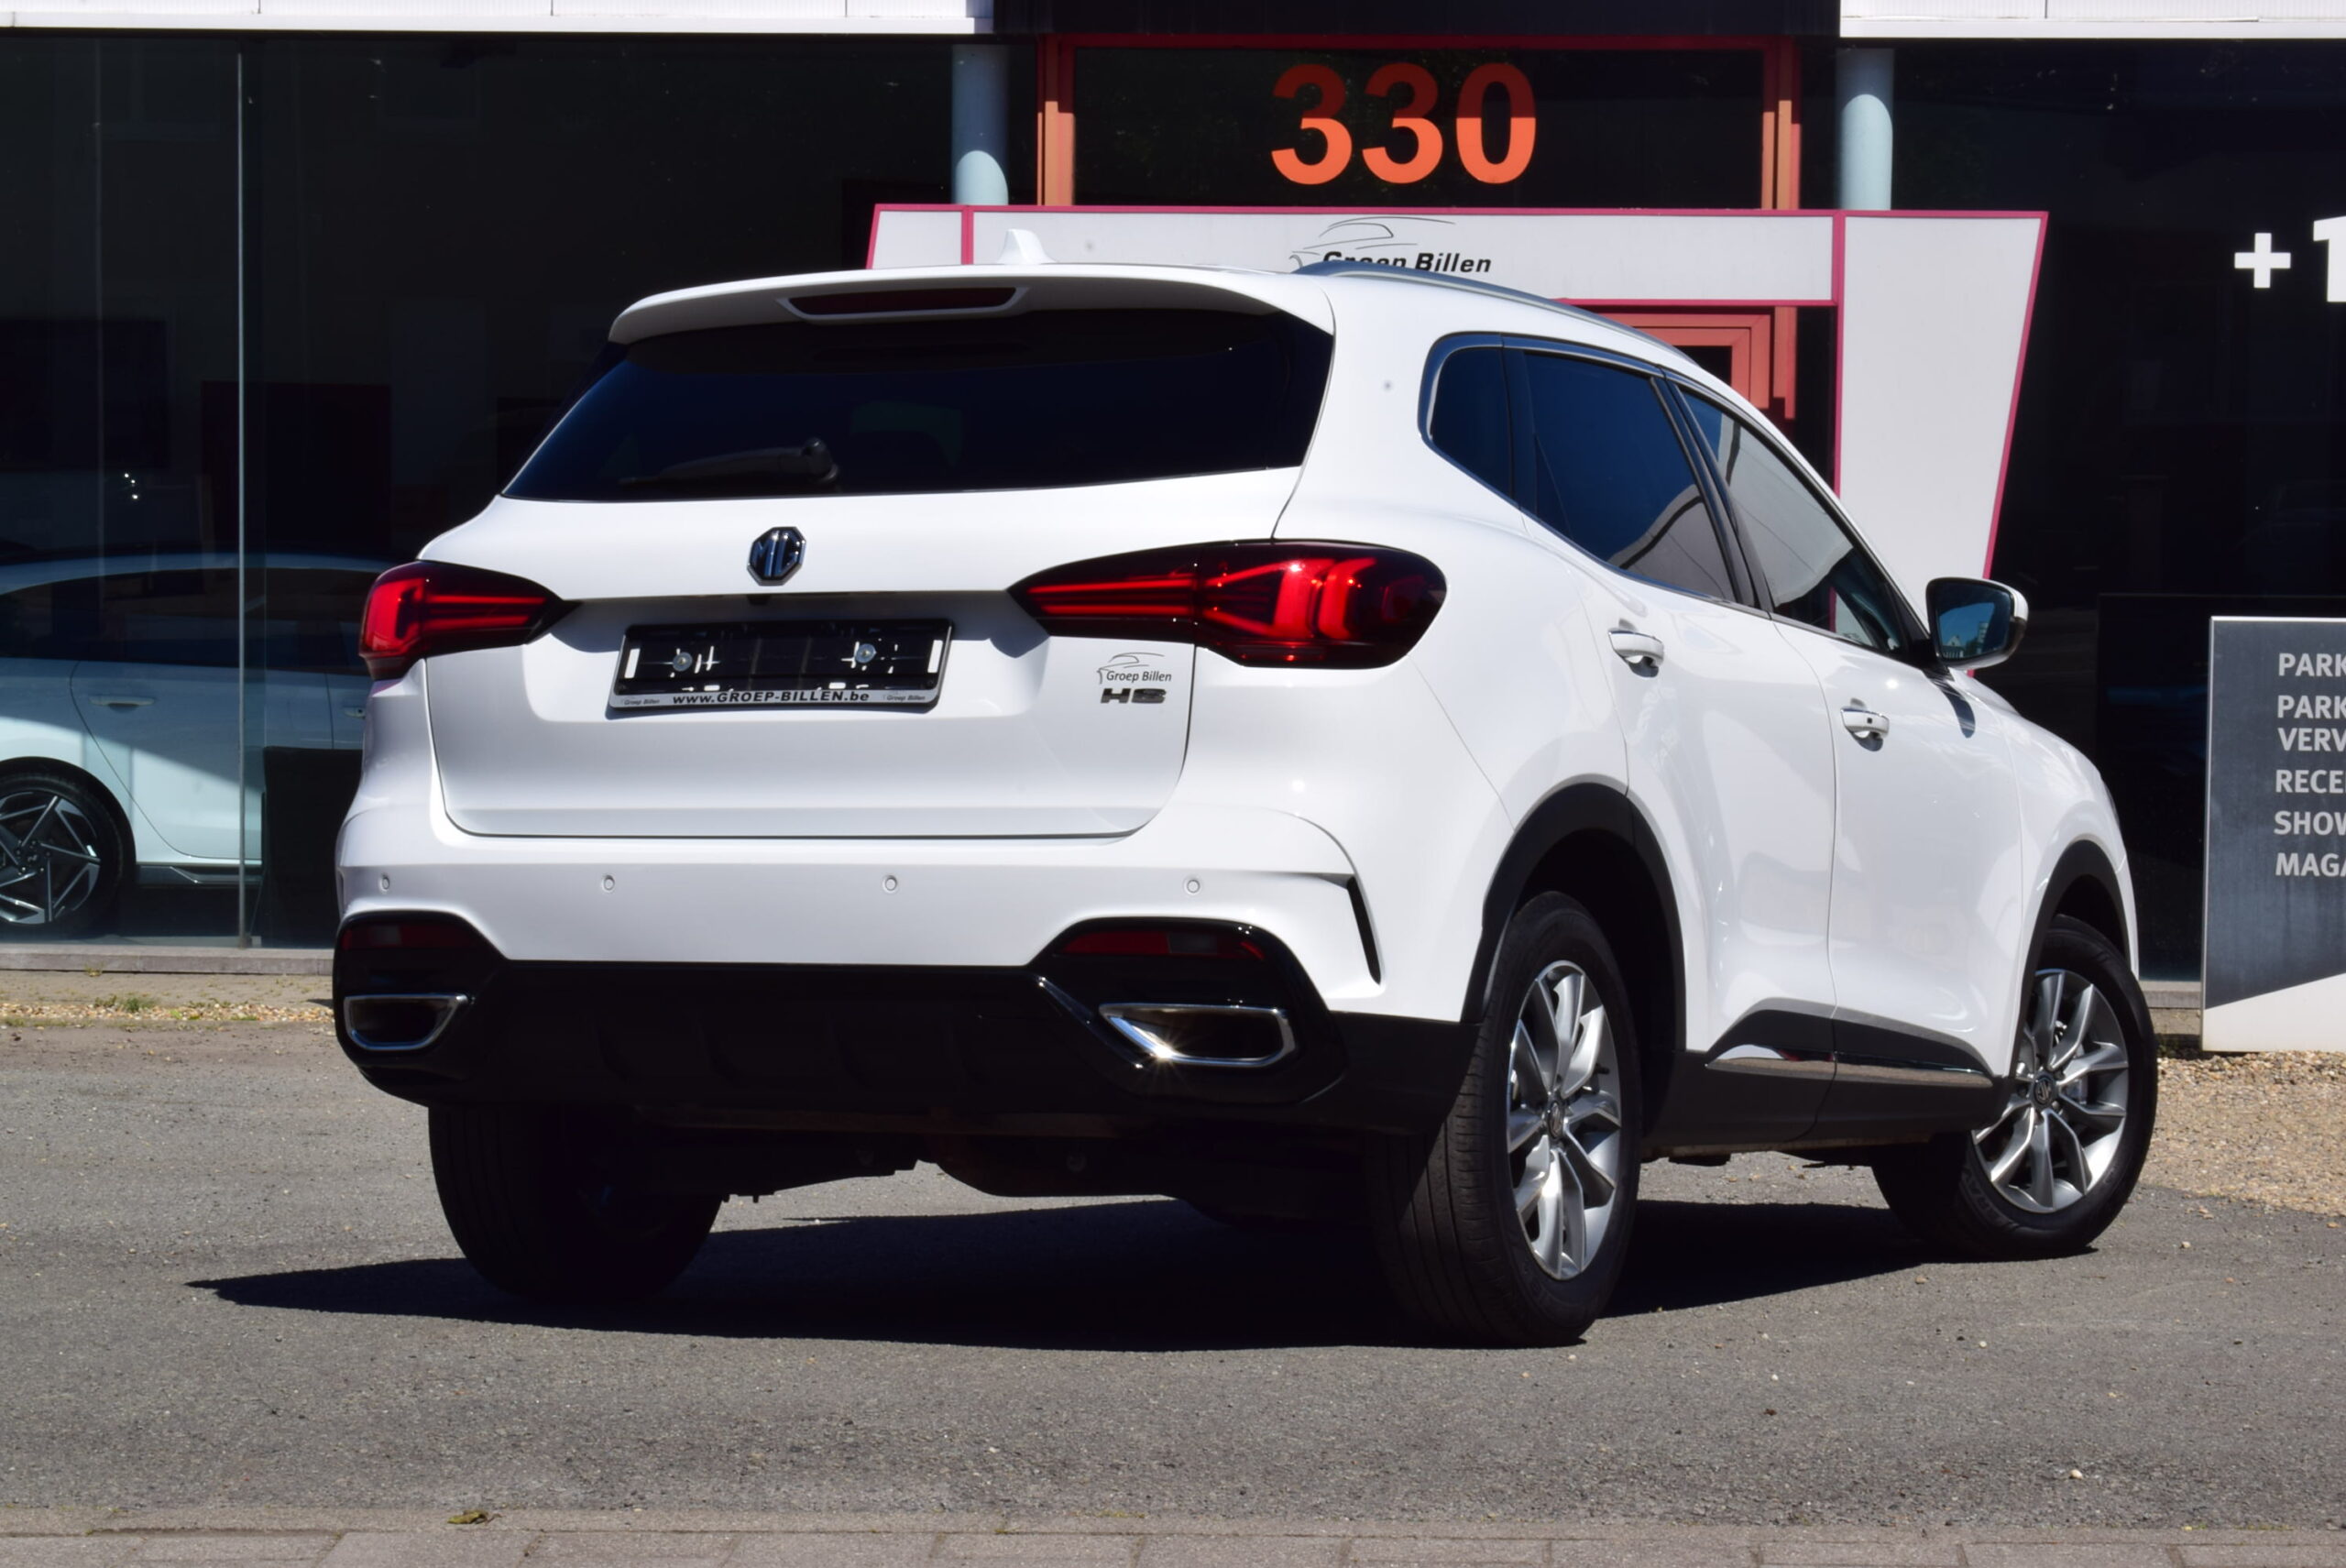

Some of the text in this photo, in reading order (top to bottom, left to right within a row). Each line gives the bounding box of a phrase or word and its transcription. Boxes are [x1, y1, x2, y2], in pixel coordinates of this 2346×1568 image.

[1271, 62, 1537, 185] 330
[1415, 252, 1492, 273] Billen
[1105, 670, 1172, 684] Groep Billen
[673, 690, 870, 704] www.GROEP-BILLEN.be
[1100, 687, 1167, 704] HS
[2275, 768, 2346, 795] RECE
